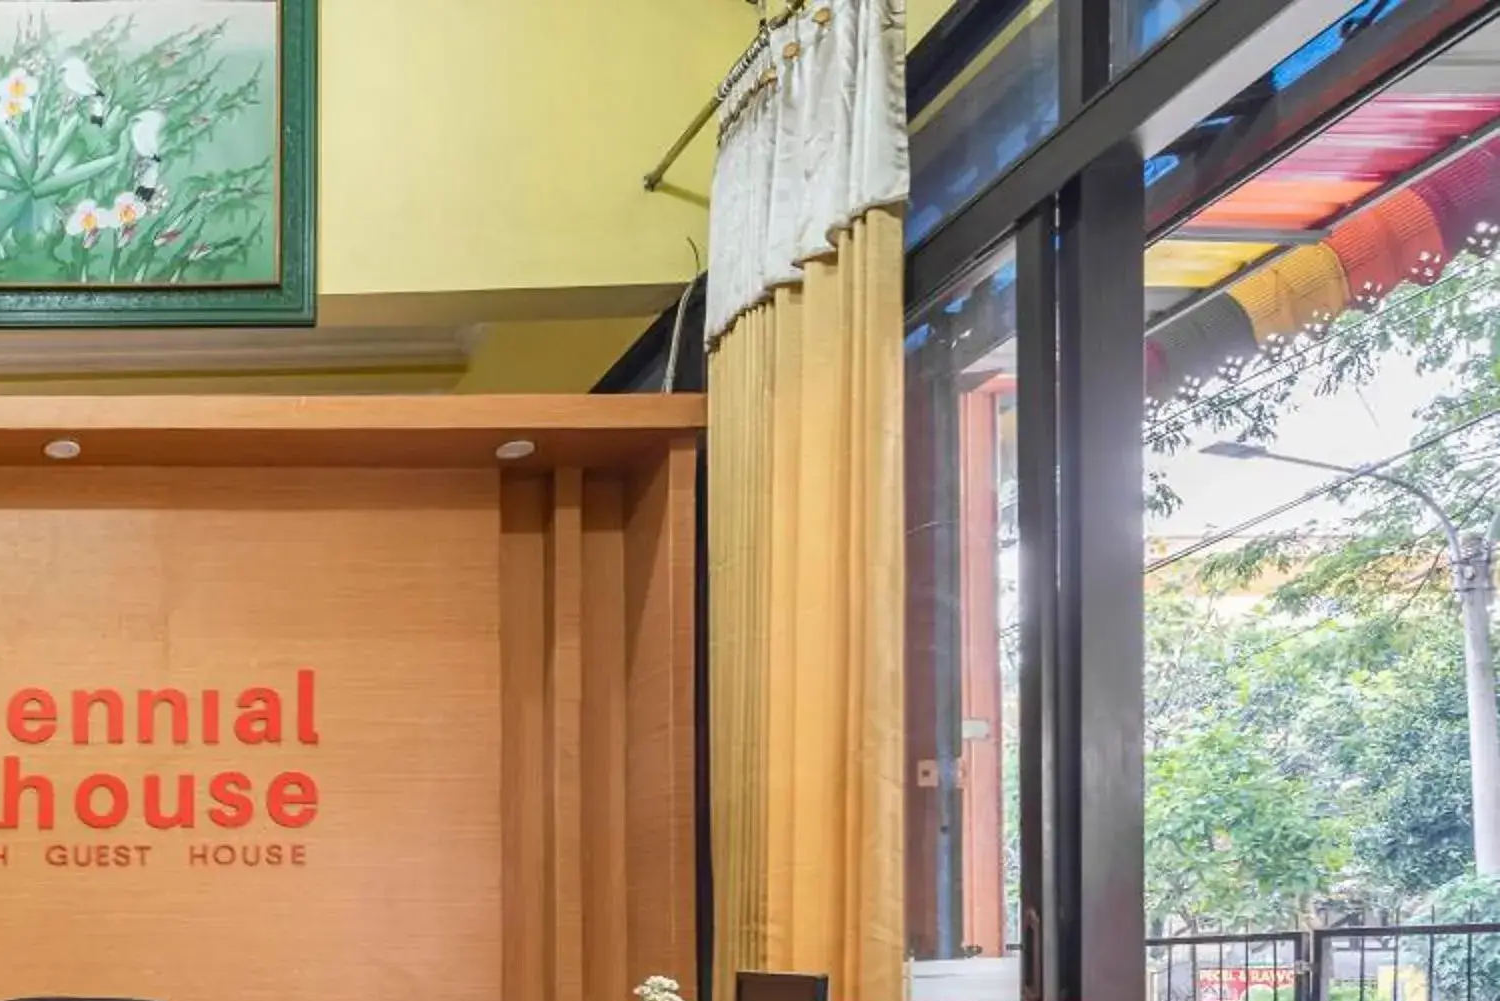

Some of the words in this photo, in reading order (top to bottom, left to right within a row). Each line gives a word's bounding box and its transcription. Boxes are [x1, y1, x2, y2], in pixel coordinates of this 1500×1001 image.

[2, 755, 320, 830] house
[44, 843, 152, 868] GUEST
[188, 842, 307, 867] HOUSE
